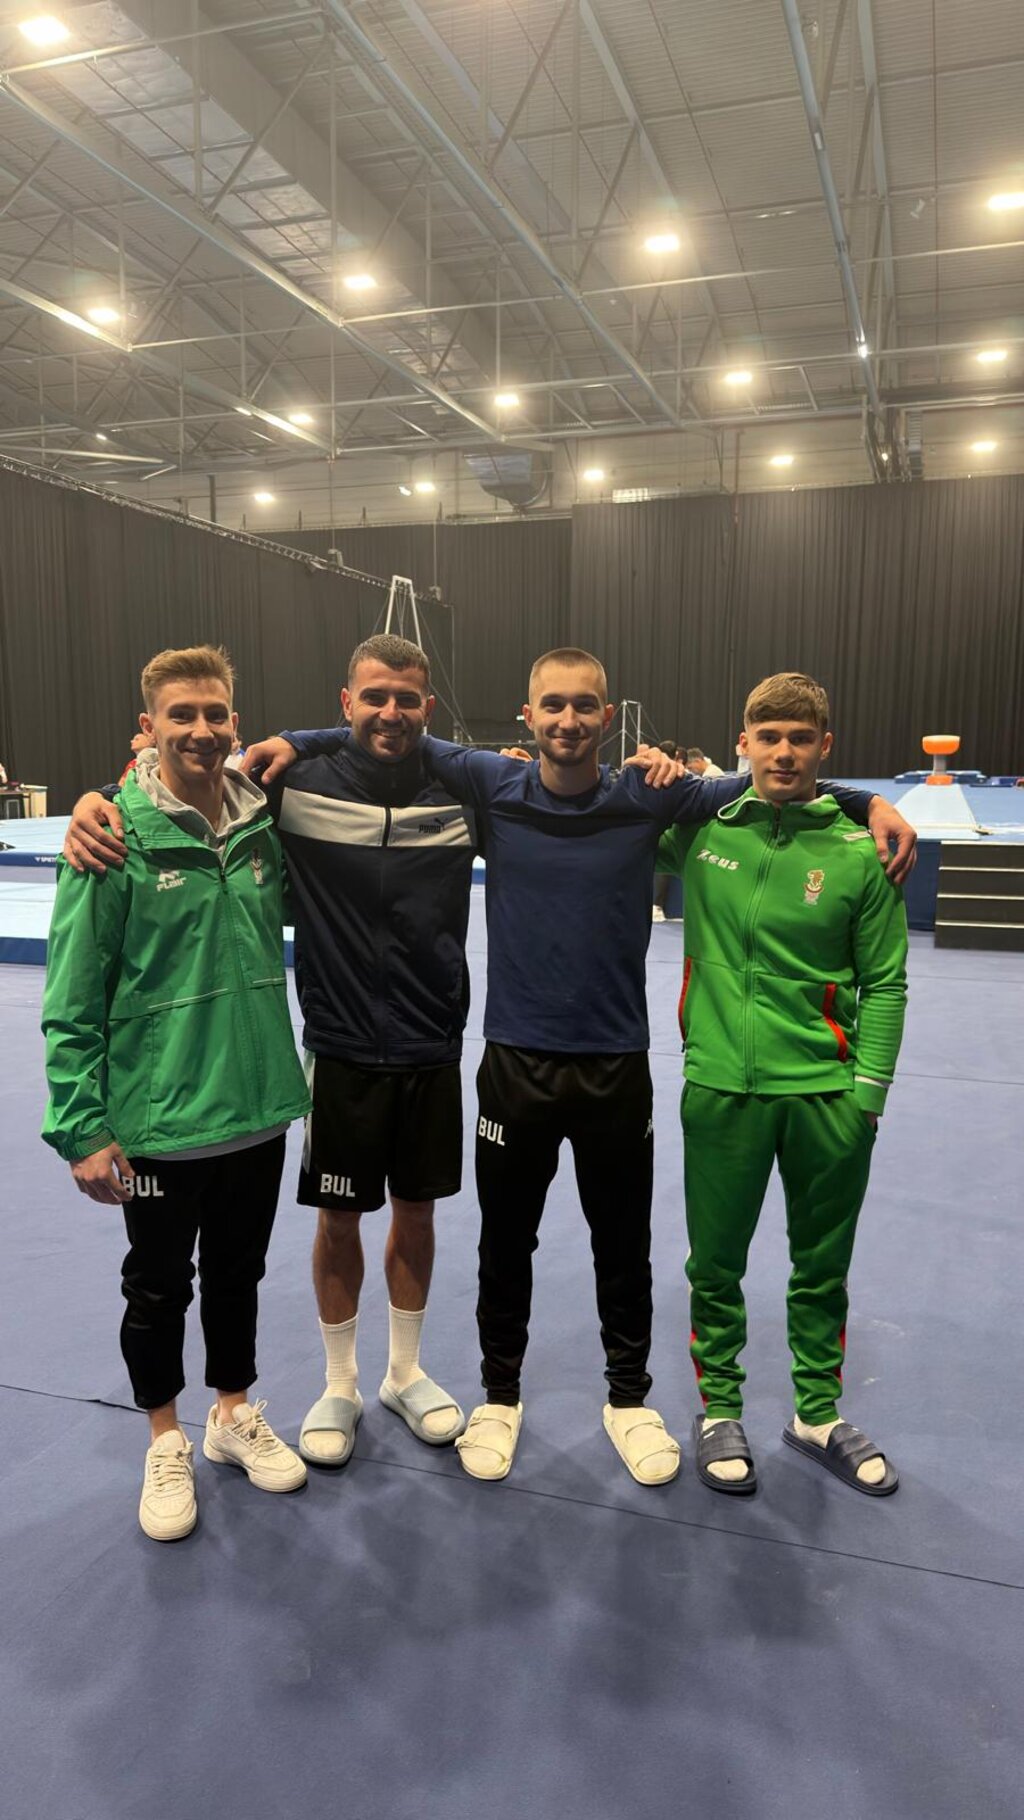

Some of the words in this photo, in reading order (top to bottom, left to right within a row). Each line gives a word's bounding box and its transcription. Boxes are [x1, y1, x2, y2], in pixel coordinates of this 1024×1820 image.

[697, 849, 739, 870] Zeus
[478, 1115, 505, 1147] BUL
[121, 1175, 164, 1197] BUL
[320, 1173, 356, 1197] BUL
